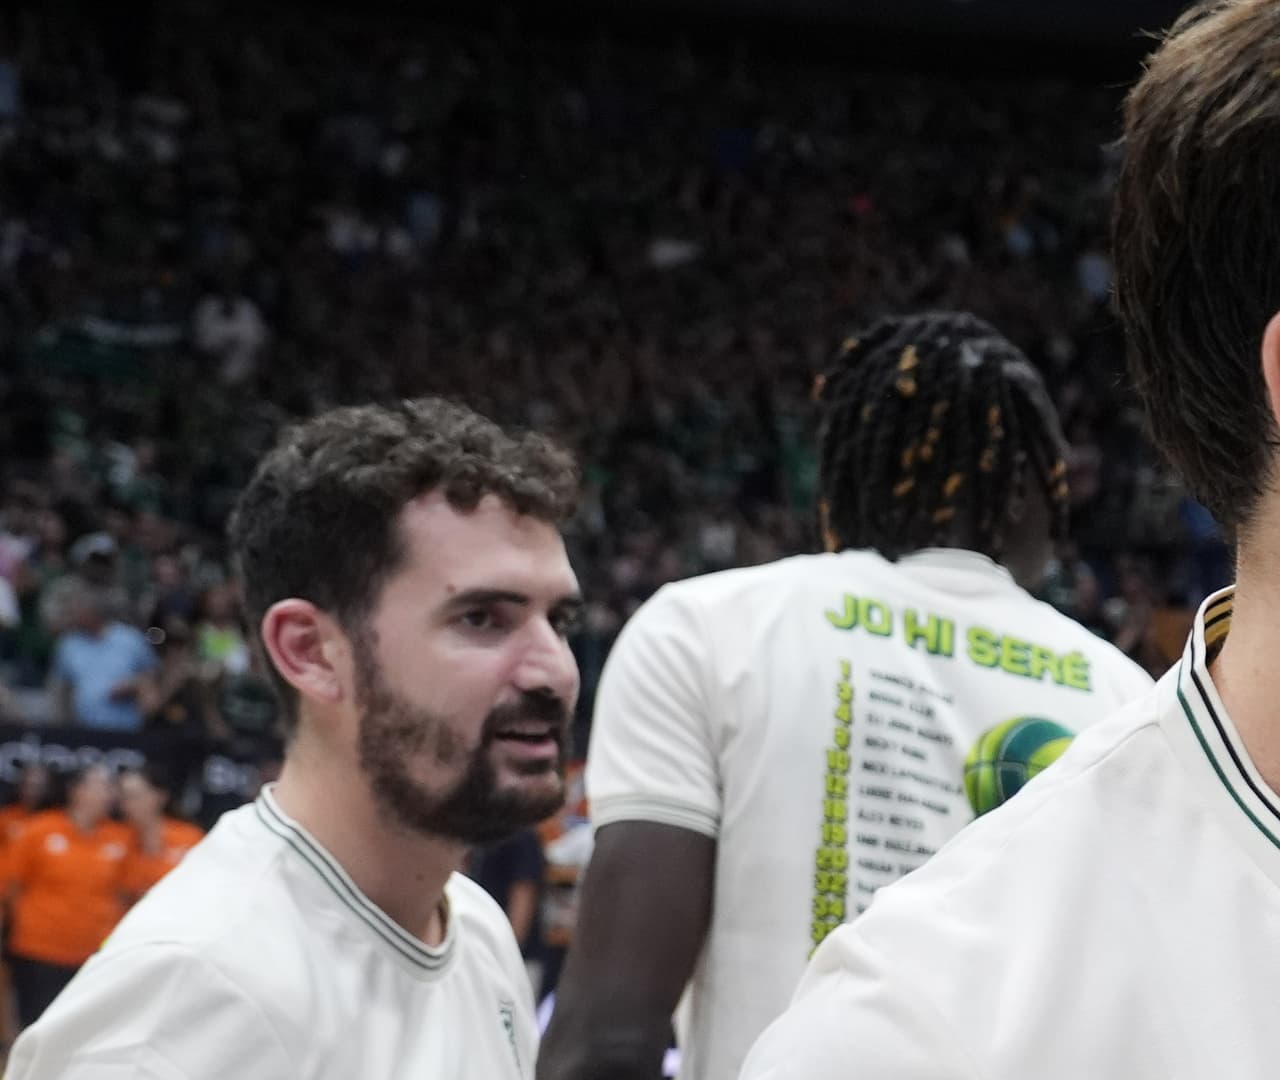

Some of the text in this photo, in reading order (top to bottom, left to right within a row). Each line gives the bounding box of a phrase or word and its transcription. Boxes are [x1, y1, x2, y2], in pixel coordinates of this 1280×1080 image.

[825, 593, 893, 637] JO
[903, 608, 955, 657] HI
[966, 626, 1095, 692] SERÉ
